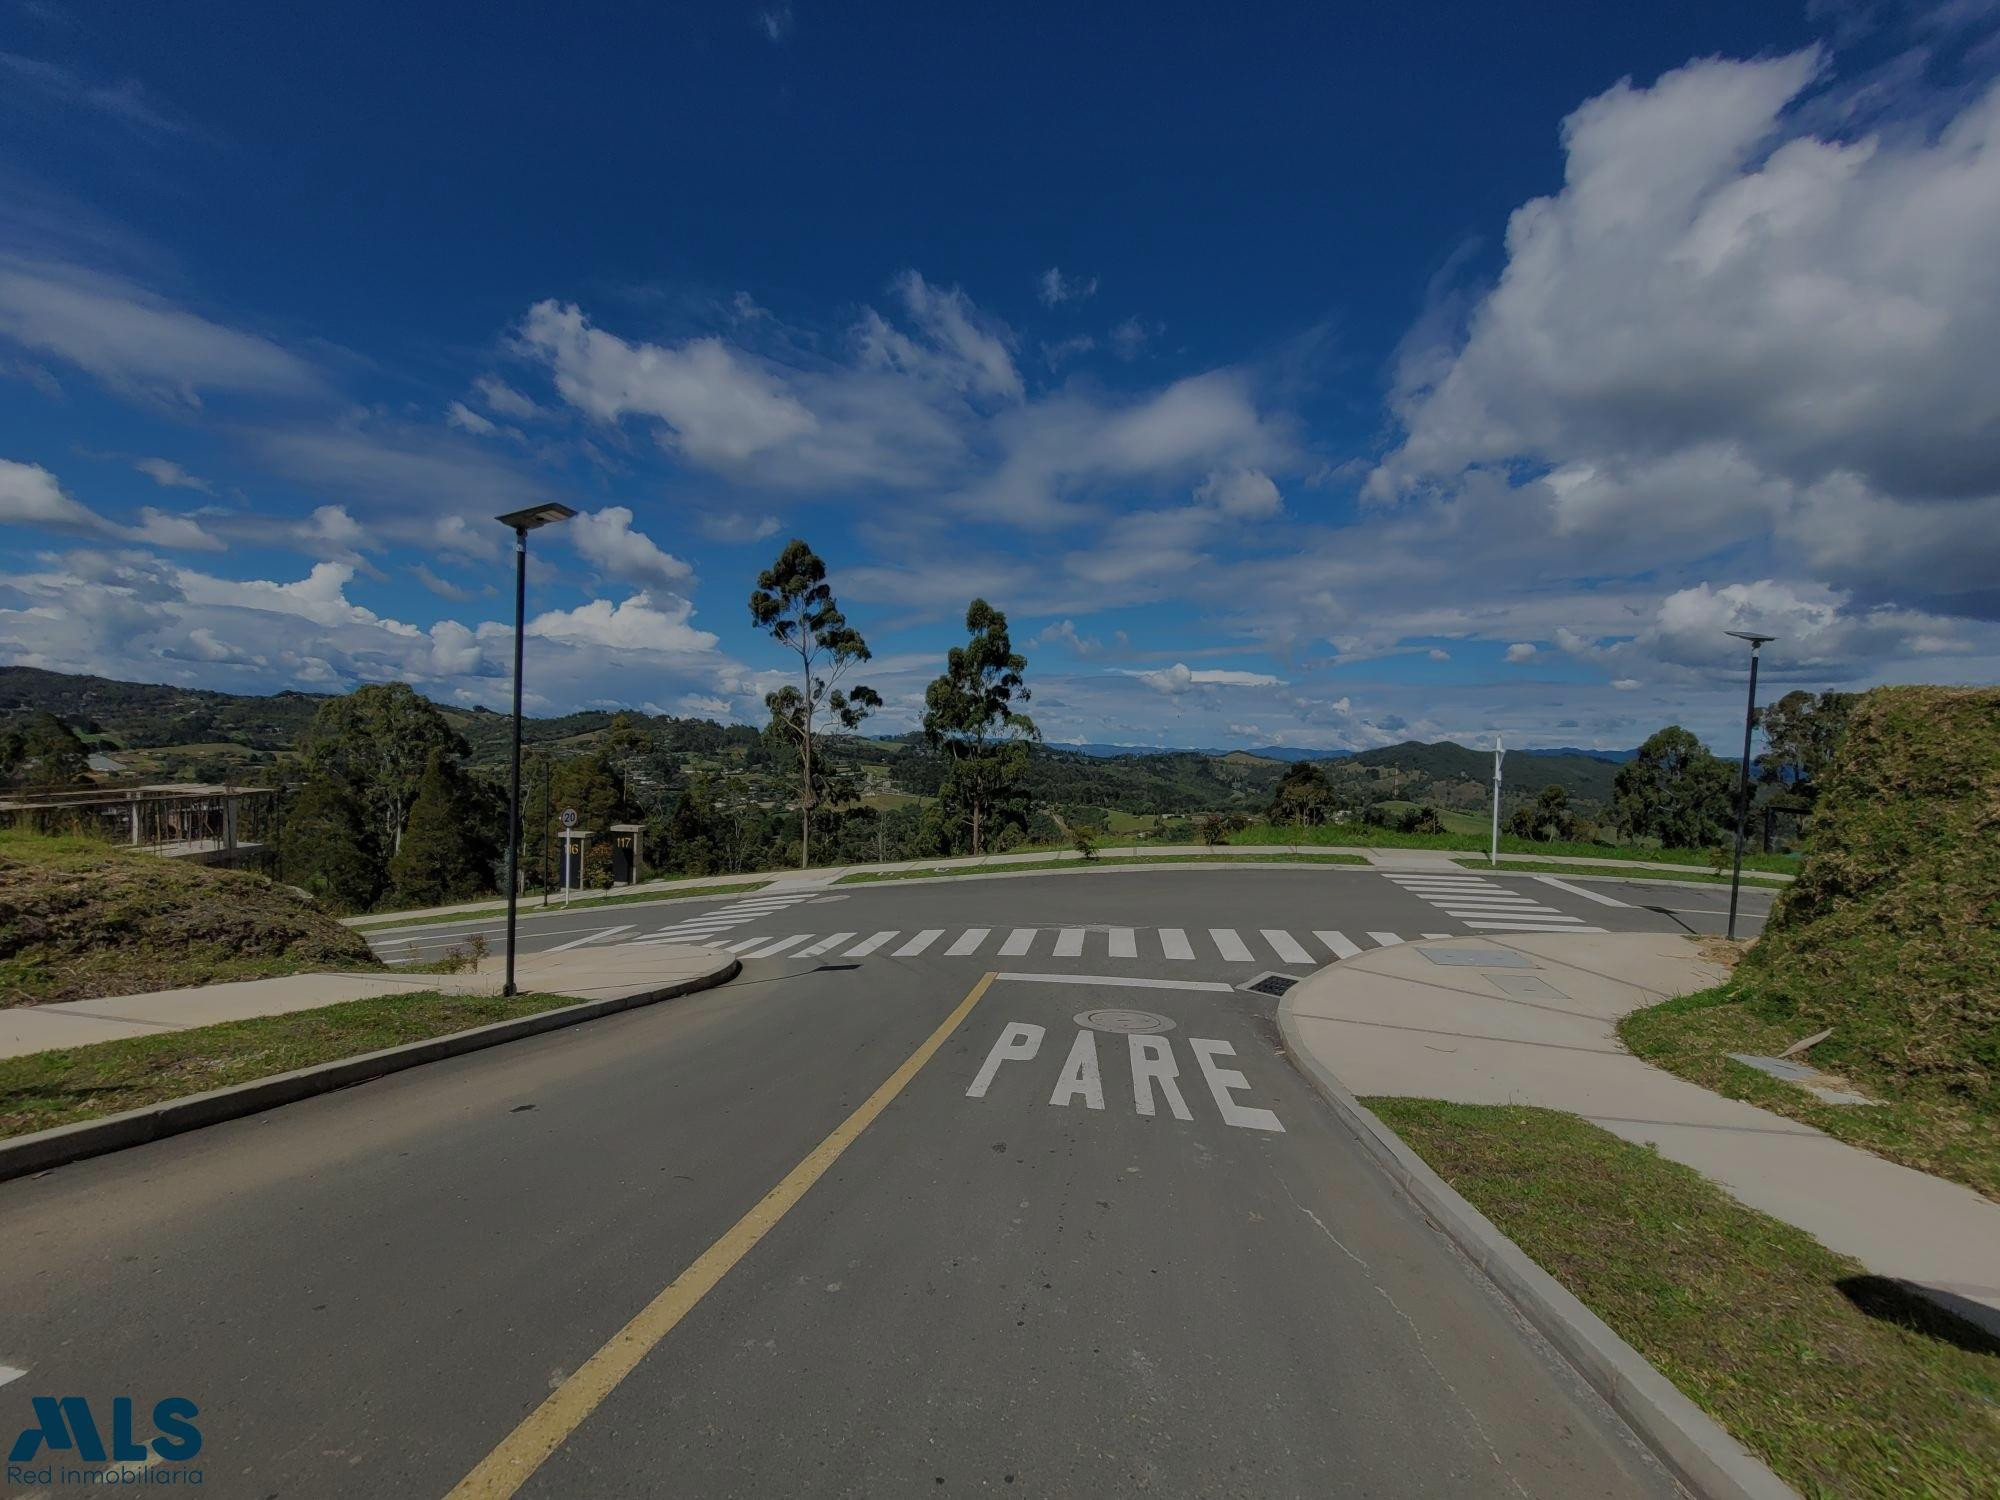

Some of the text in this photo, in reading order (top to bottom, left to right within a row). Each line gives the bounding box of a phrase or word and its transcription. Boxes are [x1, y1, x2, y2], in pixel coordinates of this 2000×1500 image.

[564, 812, 576, 823] 20
[617, 837, 632, 848] 117
[965, 1021, 1287, 1133] PARE
